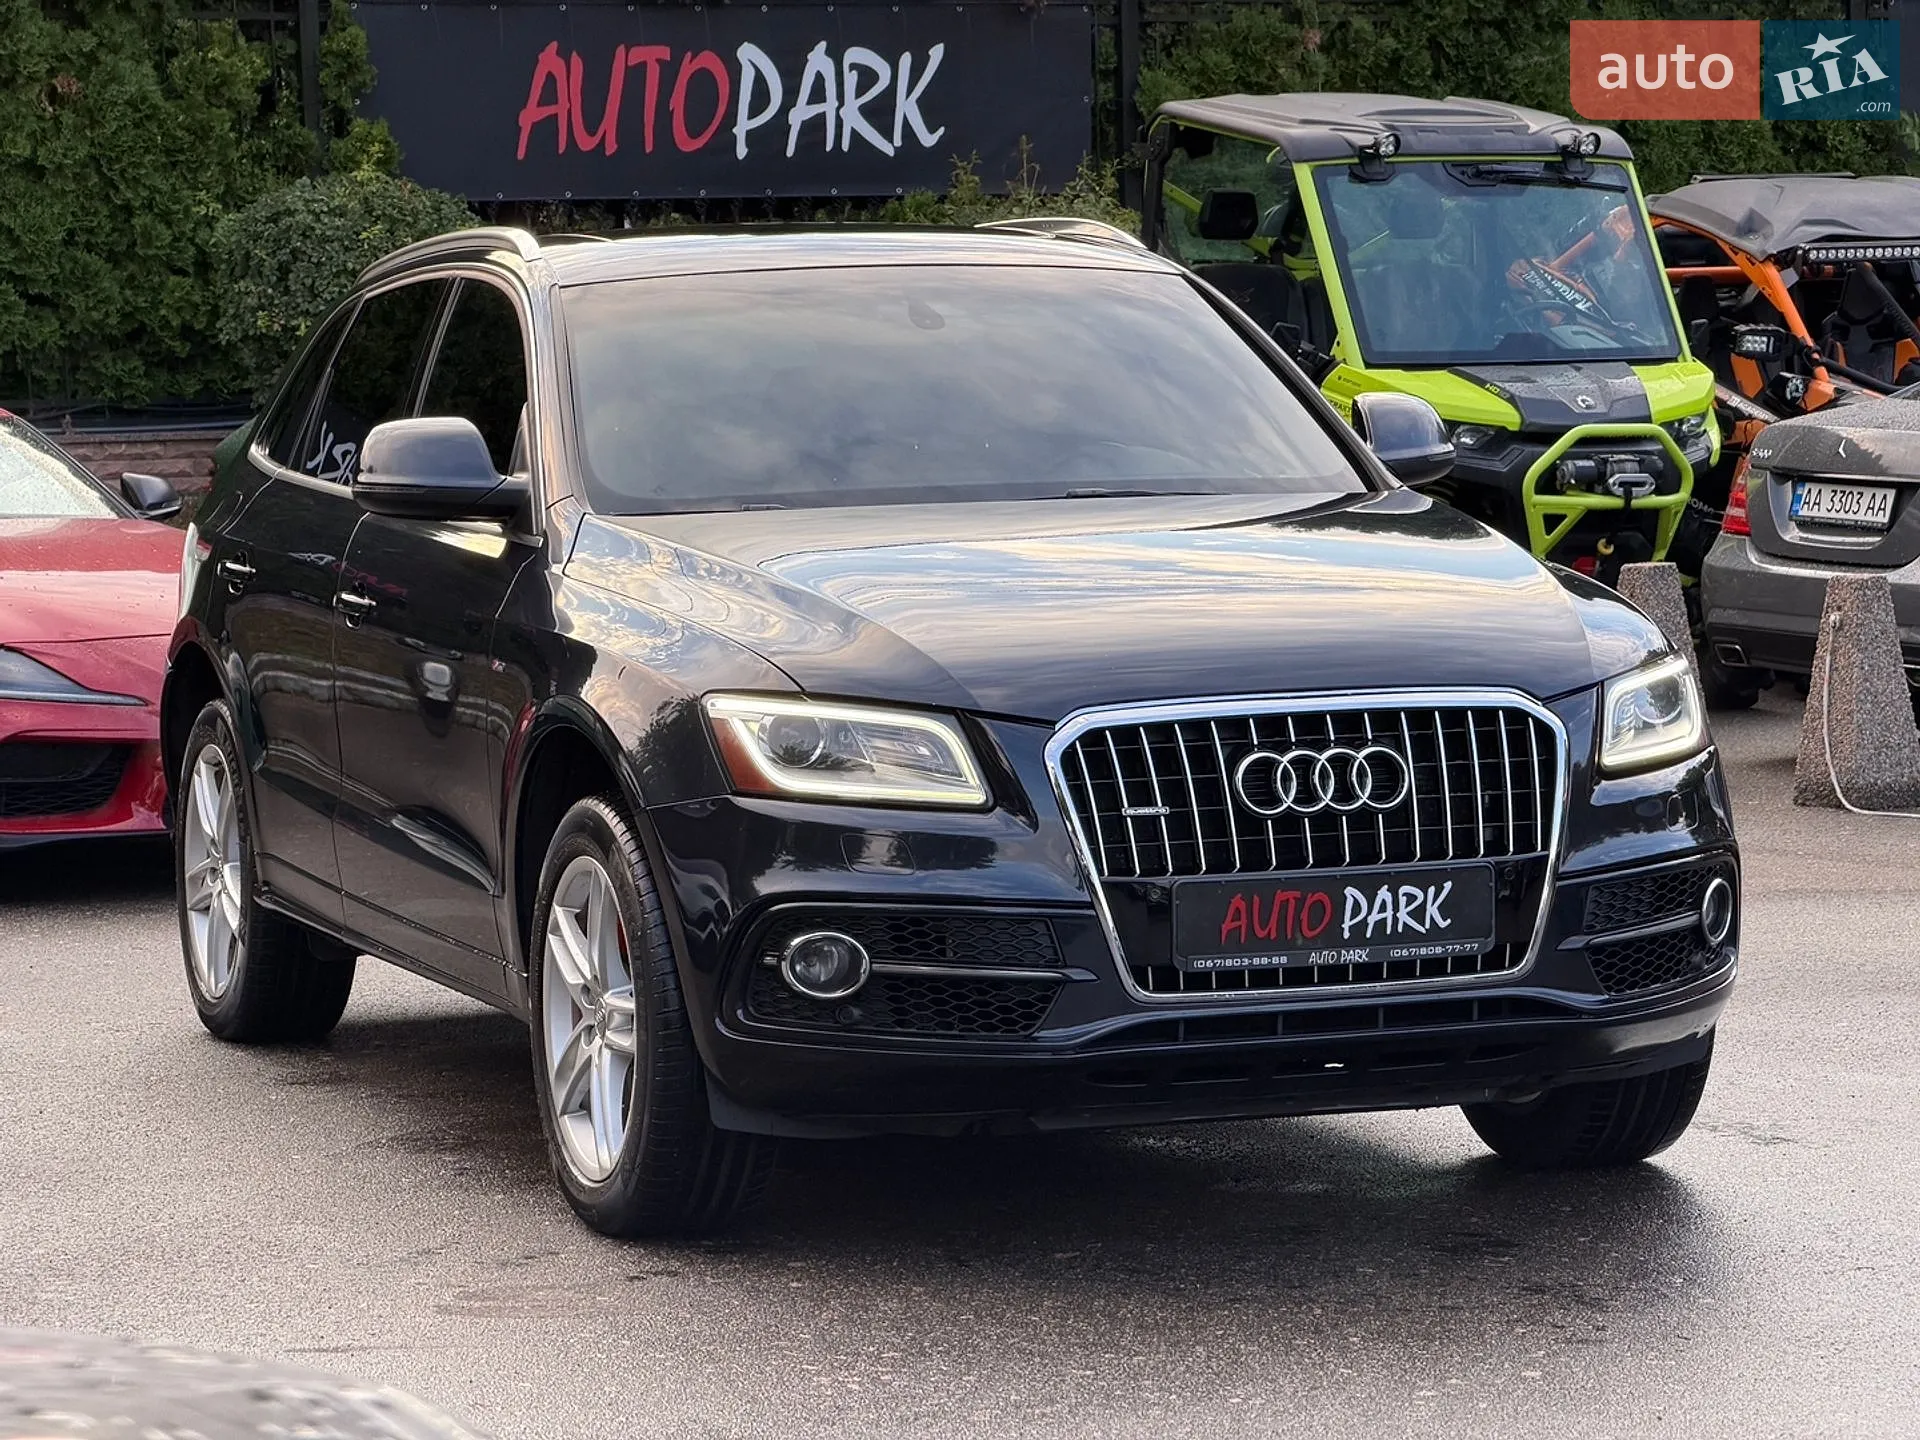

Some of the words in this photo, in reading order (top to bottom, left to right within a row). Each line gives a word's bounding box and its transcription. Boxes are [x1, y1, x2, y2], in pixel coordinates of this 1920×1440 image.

[1800, 487, 1822, 512] AA
[1826, 488, 1864, 515] 3303
[1864, 492, 1888, 518] AA
[1221, 889, 1333, 944] AUTO
[1342, 880, 1453, 940] PARK
[1193, 955, 1288, 969] (067)803-88-88
[1308, 951, 1338, 965] AUTO
[1340, 948, 1370, 964] PARK
